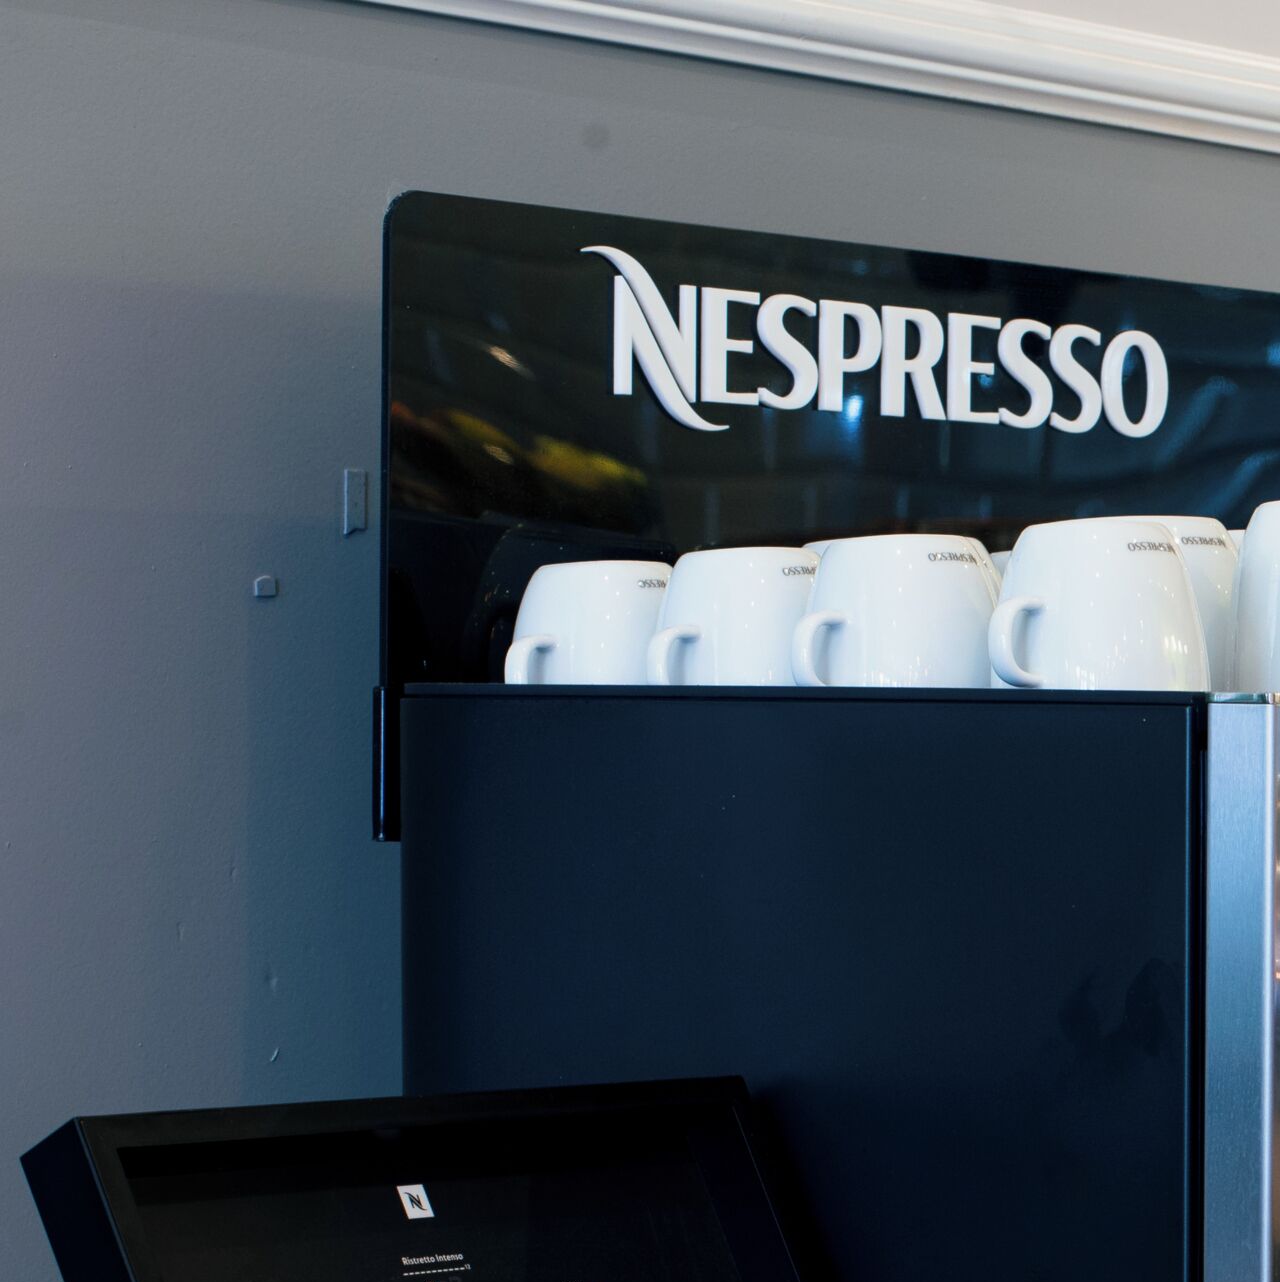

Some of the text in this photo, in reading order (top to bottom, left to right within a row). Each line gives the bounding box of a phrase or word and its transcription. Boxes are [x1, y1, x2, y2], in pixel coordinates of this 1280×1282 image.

[580, 245, 1169, 438] NESPRESSO
[782, 567, 816, 577] PRESSO
[401, 1252, 464, 1266] Ristretto Intenso
